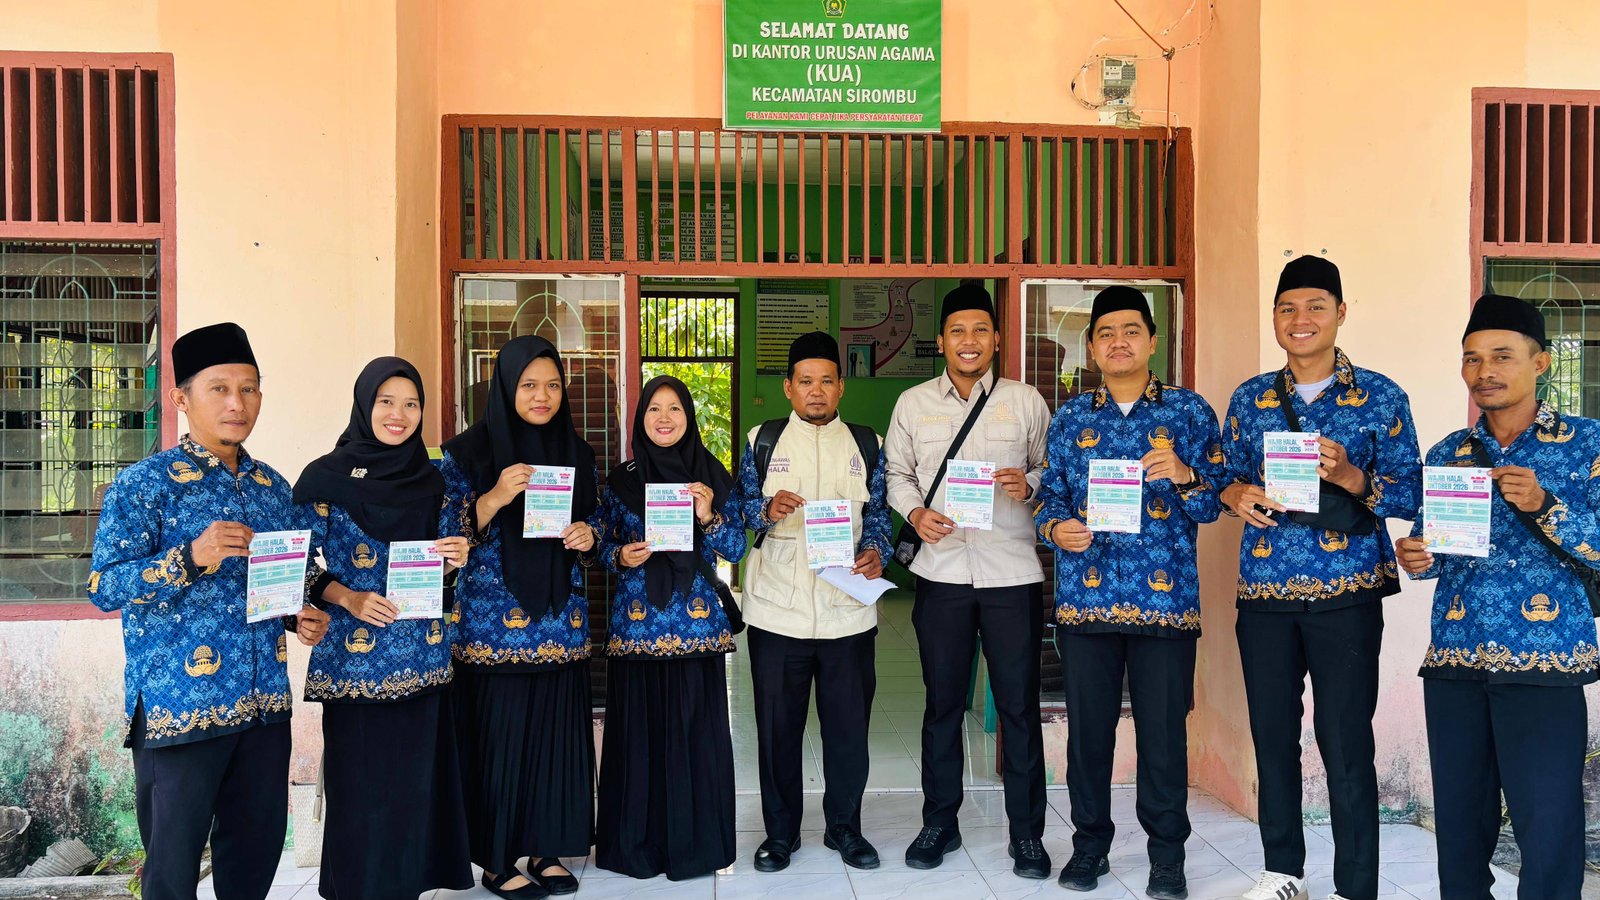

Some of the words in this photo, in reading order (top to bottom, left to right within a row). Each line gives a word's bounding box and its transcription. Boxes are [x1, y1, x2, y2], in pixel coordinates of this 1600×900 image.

[759, 21, 837, 39] SELAMAT
[842, 23, 910, 40] DATANG
[732, 44, 748, 59] DI
[752, 44, 811, 60] KANTOR
[815, 45, 878, 61] URUSAN
[880, 46, 936, 62] AGAMA
[806, 63, 862, 86] (KUA)
[751, 87, 843, 103] KECAMATAN
[846, 88, 918, 104] SIROMBU
[746, 111, 789, 121] PELAYANAN
[789, 112, 809, 121] KAMI
[810, 112, 833, 121] CEPAT
[833, 112, 849, 121] JIKA
[850, 113, 900, 122] PERSYARATAN
[900, 114, 923, 122] TEPAT
[1452, 483, 1469, 491] 2026
[274, 545, 289, 554] 2026
